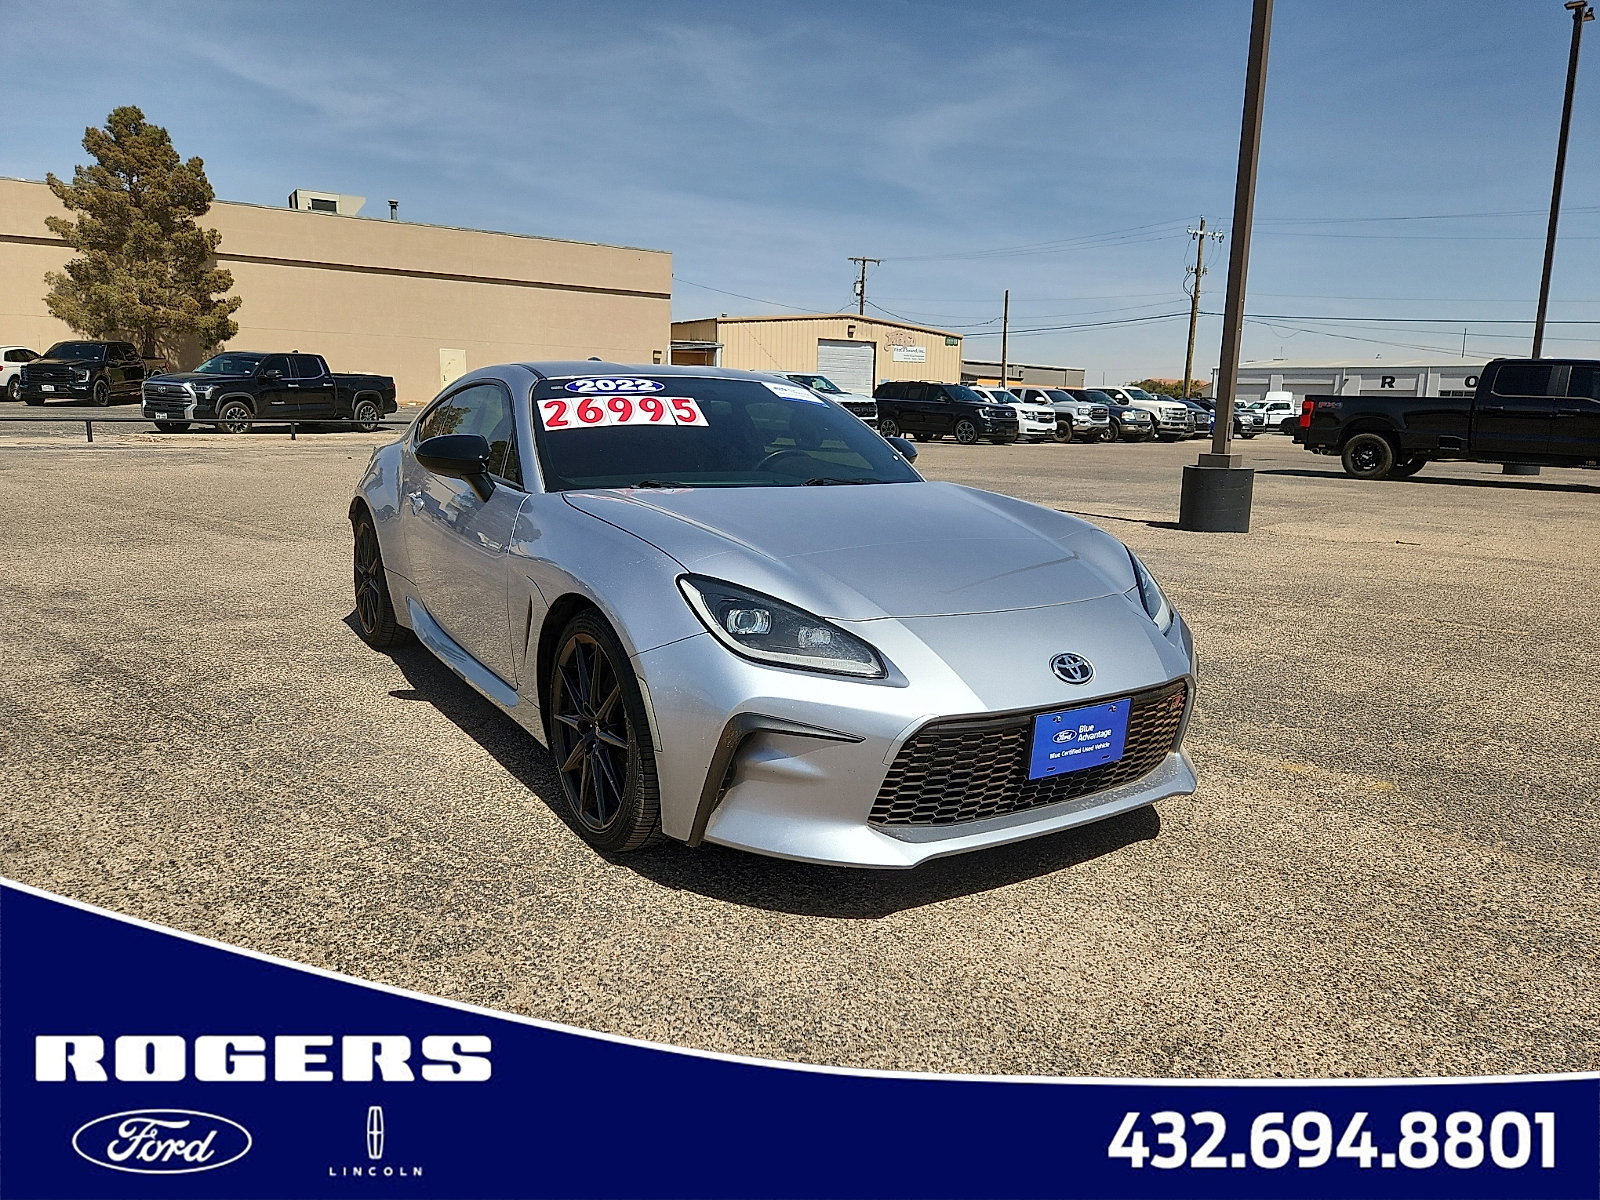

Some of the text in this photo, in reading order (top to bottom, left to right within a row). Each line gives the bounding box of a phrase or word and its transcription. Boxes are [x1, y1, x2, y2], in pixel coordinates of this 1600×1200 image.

[575, 379, 657, 391] 2022
[1381, 376, 1396, 388] R
[544, 397, 697, 427] 26995
[1078, 724, 1094, 733] Blue
[1077, 729, 1112, 742] Advantage
[1061, 747, 1082, 756] Certified
[1095, 742, 1111, 750] Vehicle
